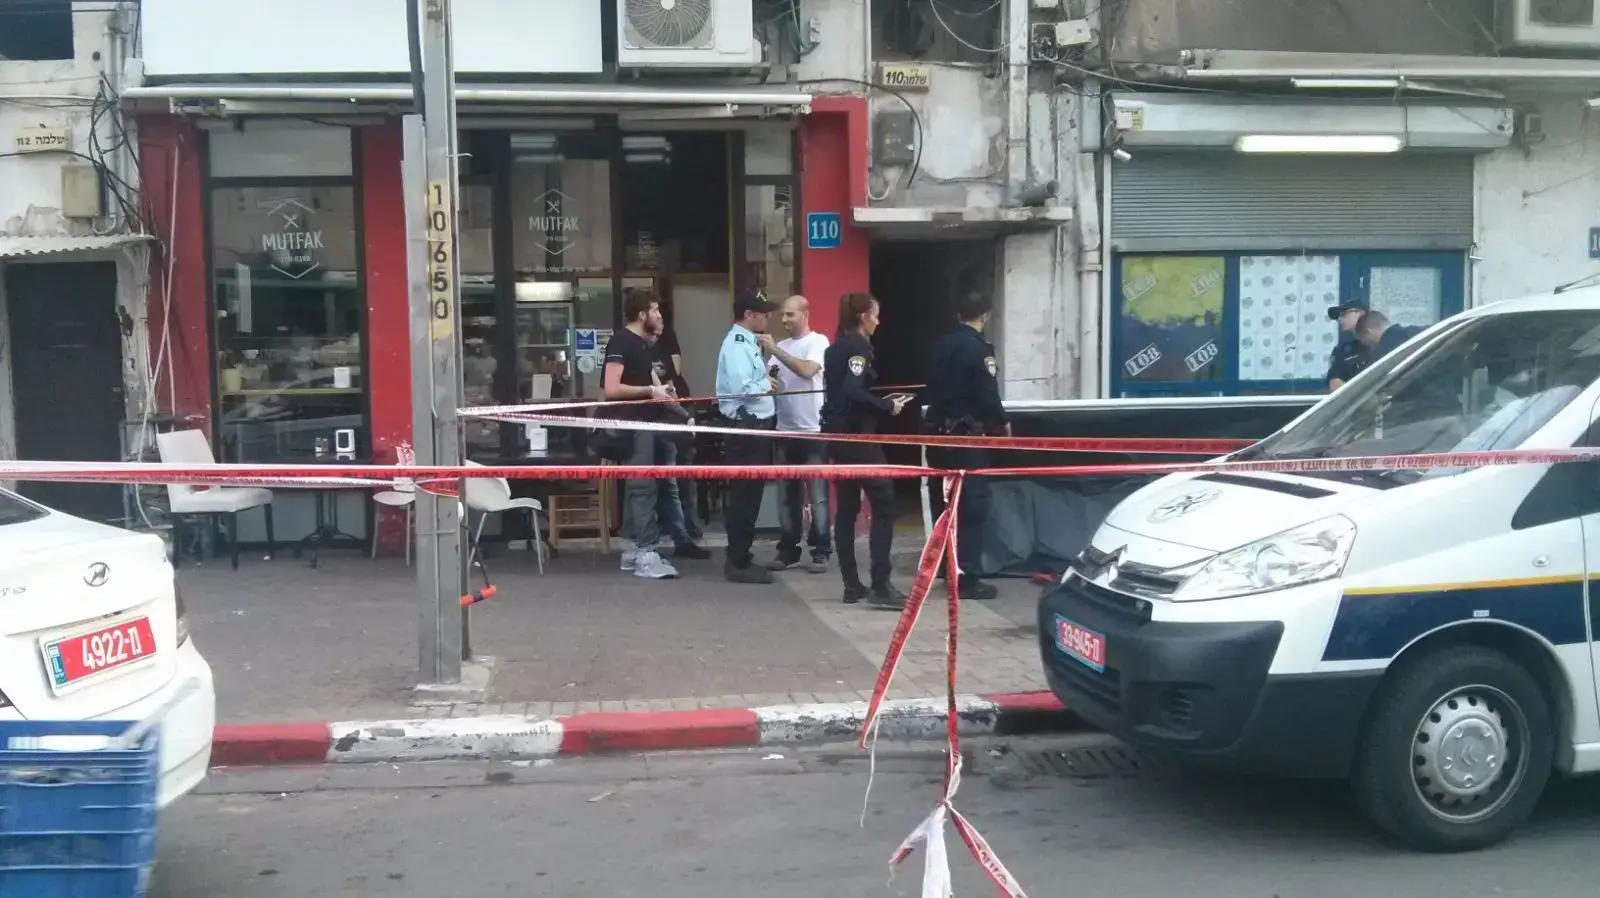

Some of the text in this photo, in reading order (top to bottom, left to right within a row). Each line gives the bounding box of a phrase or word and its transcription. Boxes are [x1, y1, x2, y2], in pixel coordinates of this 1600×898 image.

[885, 71, 903, 84] 110
[16, 132, 65, 146] שלמה 112
[528, 216, 580, 232] MUTFAK
[811, 220, 839, 240] 110
[262, 231, 325, 252] MUTFAK
[432, 184, 448, 320] 10650
[1127, 347, 1160, 374] 108
[1186, 343, 1218, 371] 108
